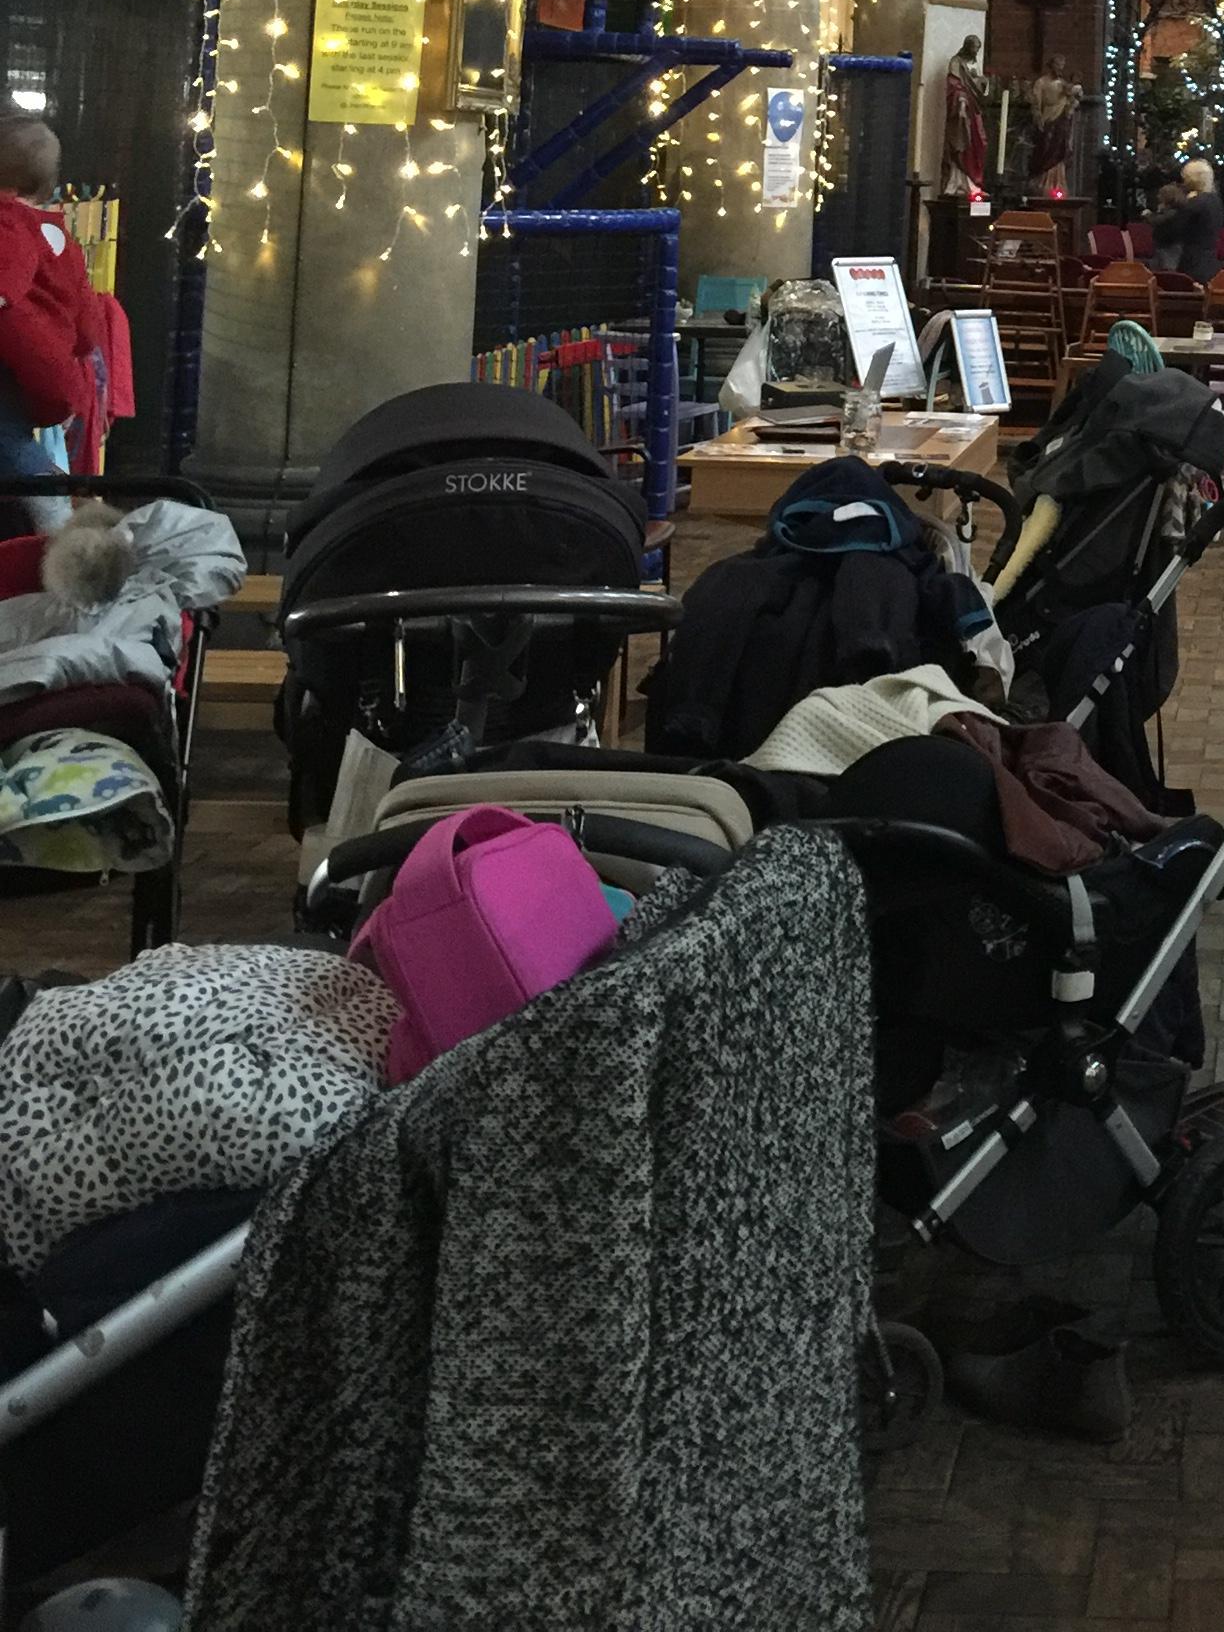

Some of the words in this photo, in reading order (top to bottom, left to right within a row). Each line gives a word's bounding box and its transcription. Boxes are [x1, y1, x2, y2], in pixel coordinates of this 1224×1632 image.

[361, 27, 376, 35] run
[348, 37, 377, 49] tarting
[381, 40, 389, 48] at
[367, 66, 375, 74] at
[378, 66, 383, 74] 4
[445, 472, 527, 493] STOKKE
